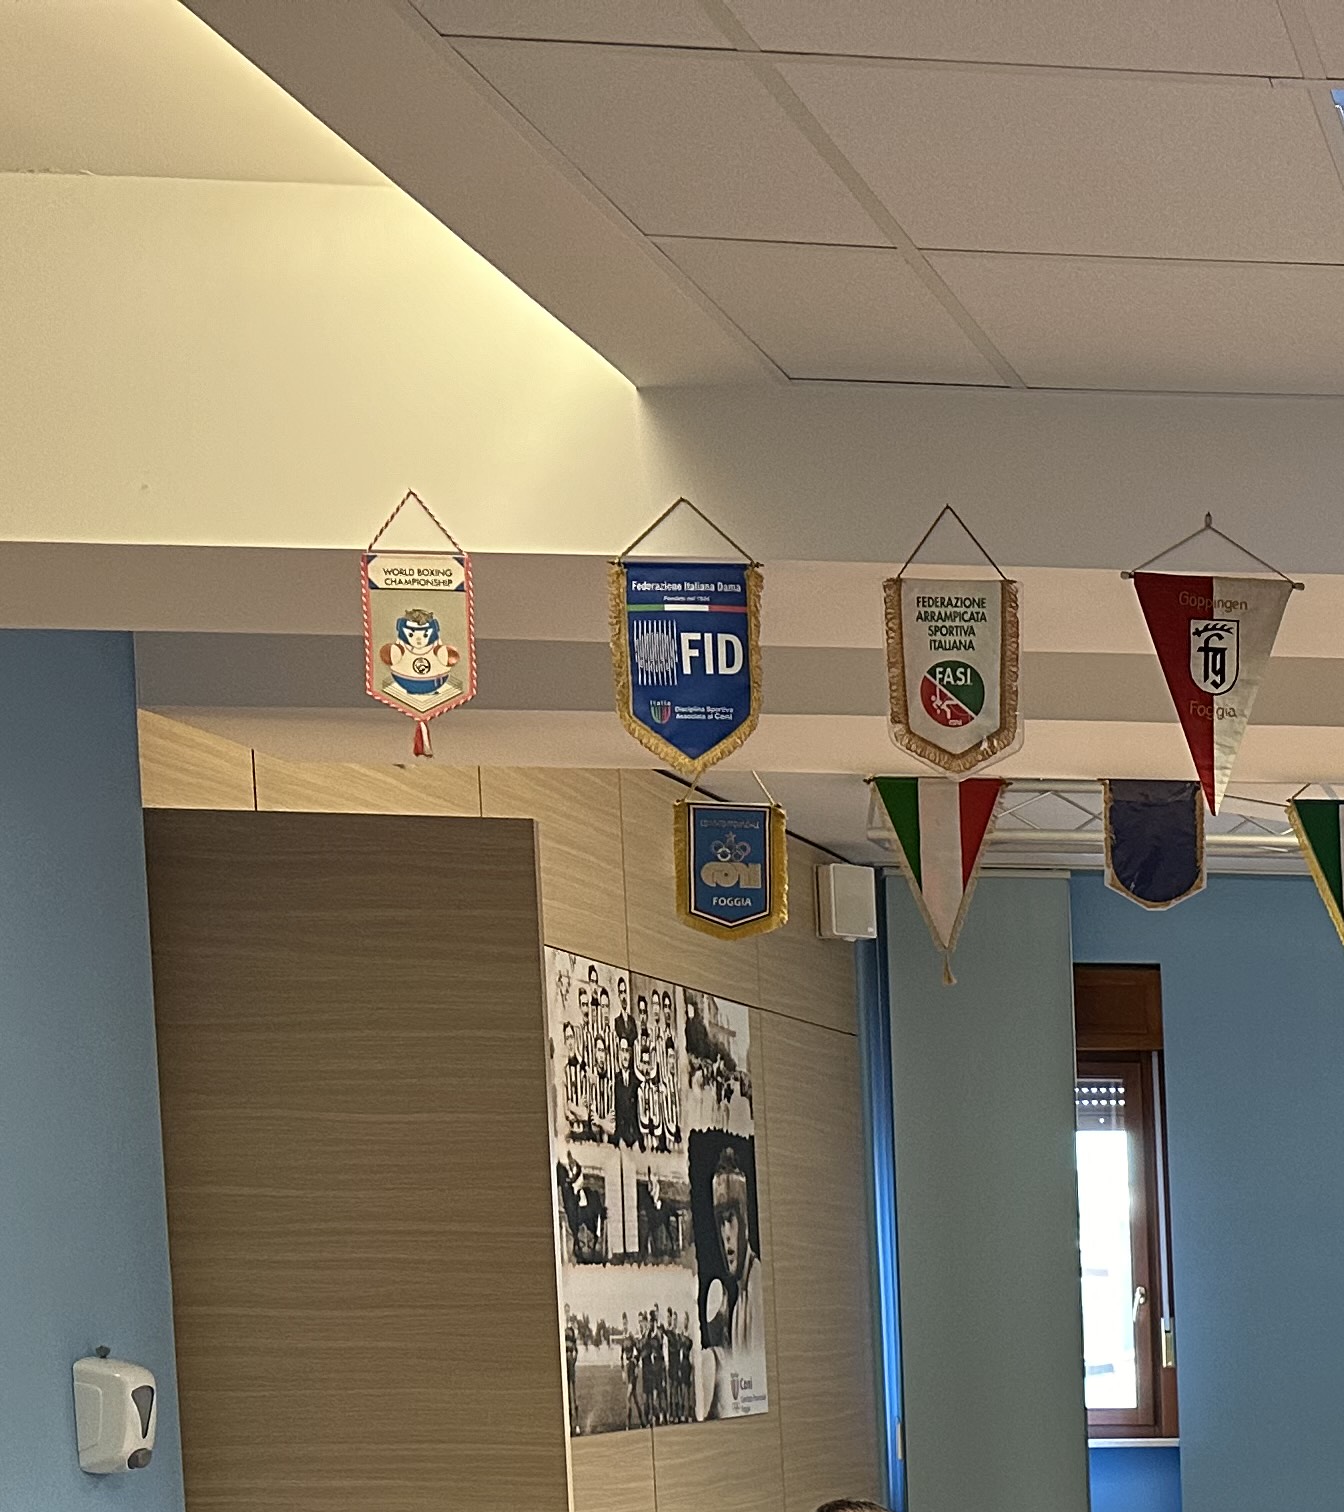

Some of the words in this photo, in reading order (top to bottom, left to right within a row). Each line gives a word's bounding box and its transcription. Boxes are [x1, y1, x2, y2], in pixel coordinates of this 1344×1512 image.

[382, 567, 415, 577] WORLD
[417, 568, 453, 578] BOXING
[384, 577, 453, 587] CHAMPIONSHIP
[631, 580, 683, 592] Federazione
[717, 581, 742, 593] Dama
[916, 596, 987, 609] FEDERAZIONE
[916, 611, 987, 623] ARRAMPICATA
[928, 625, 976, 637] SPORTIVA
[929, 639, 976, 651] ITALIANA
[680, 632, 744, 675] FID
[1189, 700, 1238, 720] Foggia
[712, 896, 752, 907] FOGGIA
